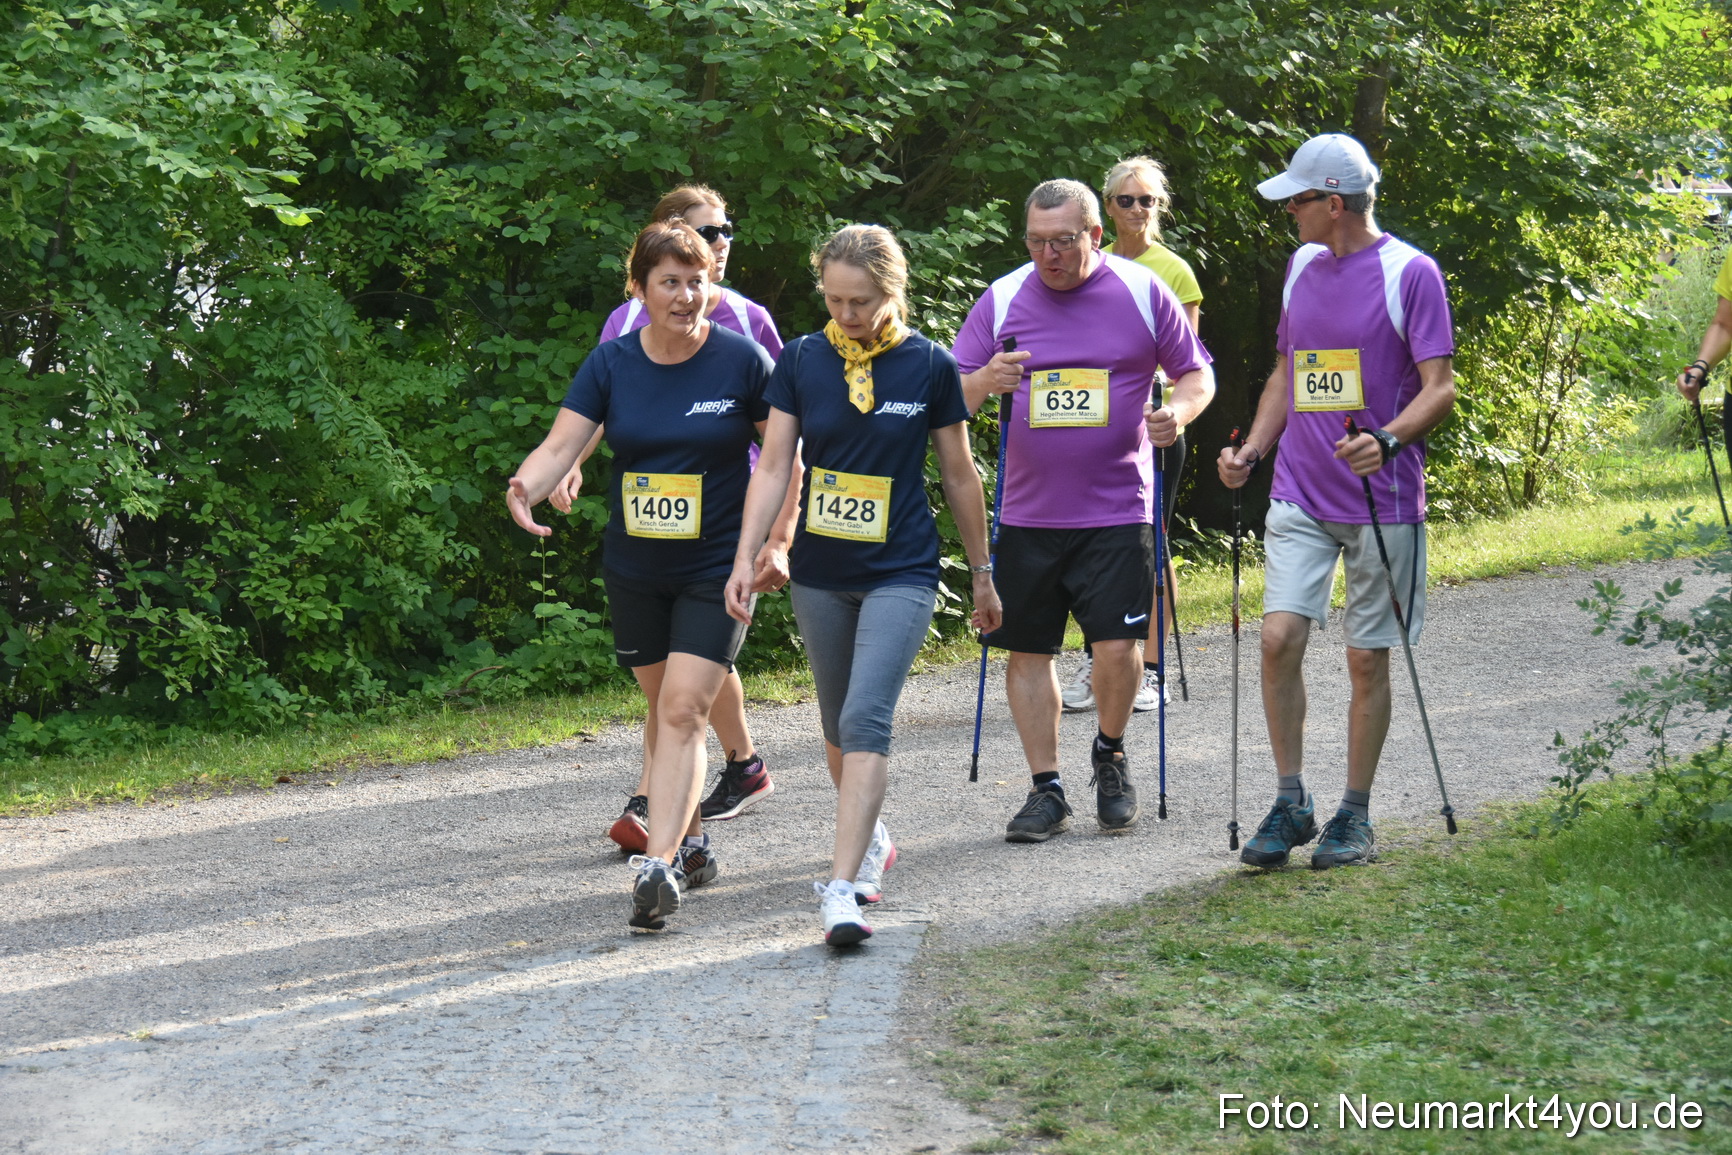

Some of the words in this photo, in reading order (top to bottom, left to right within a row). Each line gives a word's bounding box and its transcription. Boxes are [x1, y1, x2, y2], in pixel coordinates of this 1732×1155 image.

[1306, 372, 1343, 394] 640
[685, 401, 722, 416] JURA
[874, 401, 914, 415] JURA
[1046, 390, 1090, 411] 632
[631, 496, 689, 520] 1409
[816, 493, 876, 523] 1428
[823, 518, 846, 527] Nunner
[846, 521, 863, 529] Gabi
[839, 527, 861, 535] Neumarkt
